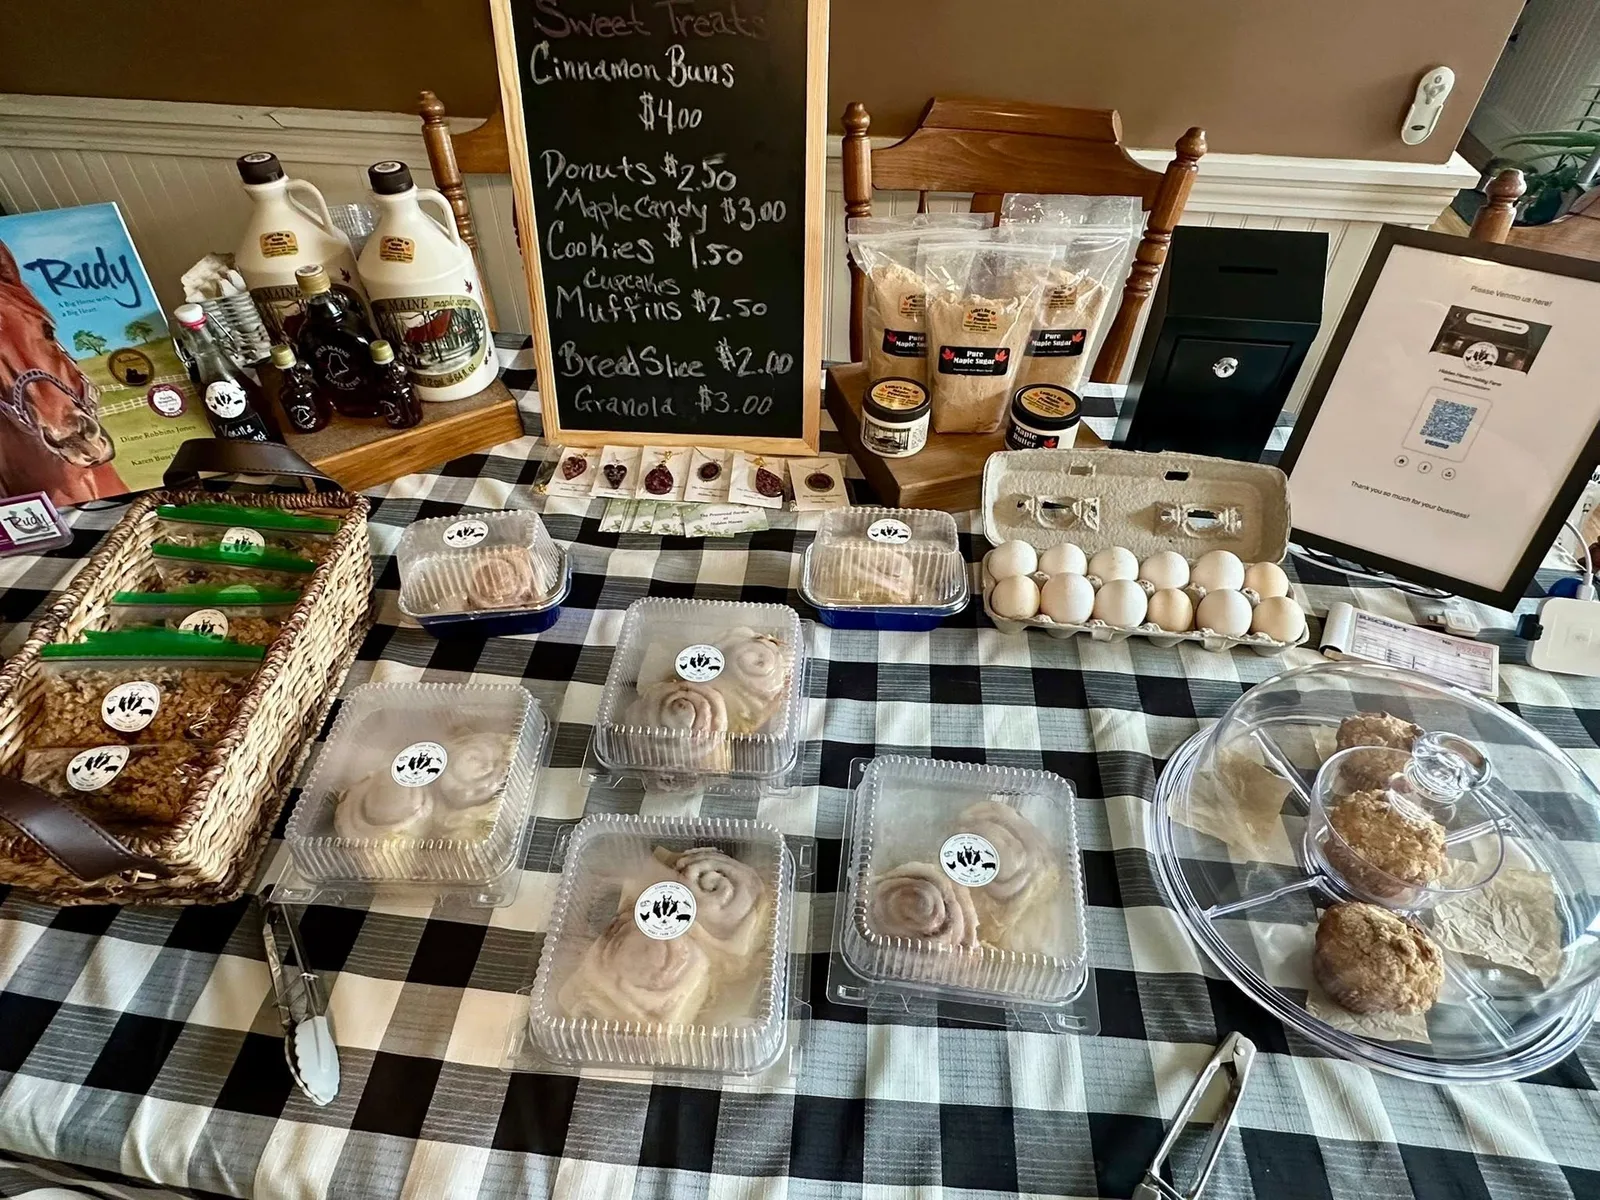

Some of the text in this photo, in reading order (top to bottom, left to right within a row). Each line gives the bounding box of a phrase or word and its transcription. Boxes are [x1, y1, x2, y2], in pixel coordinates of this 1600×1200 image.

[533, 0, 770, 40] Sweet Treats
[530, 41, 735, 88] Cinnamon Buns
[638, 91, 703, 135] $4.00
[540, 149, 737, 192] Donuts $2.50
[554, 187, 787, 235] Maple Candy $3.00
[547, 220, 655, 264] Cookies
[23, 246, 141, 308] Rudy
[583, 267, 681, 296] Cupcakes
[388, 298, 429, 311] MAINE
[556, 285, 768, 323] Muffins $2.50
[1496, 290, 1521, 300] Venmo
[1532, 298, 1553, 307] here!
[558, 337, 794, 379] Bread Slice $2.00
[953, 357, 996, 365] Maple Sugar
[966, 350, 984, 358] Pure
[574, 384, 773, 418] Granola $3.00
[120, 425, 197, 443] Diane Robbins Jones
[218, 424, 255, 438] Vanilla
[1013, 433, 1037, 448] Butter
[1015, 425, 1038, 440] Maple
[131, 457, 154, 466] Karen
[1351, 480, 1370, 491] Thank
[1370, 487, 1383, 495] you
[1391, 493, 1411, 503] much
[1411, 498, 1421, 506] for
[1421, 502, 1437, 510] your
[1436, 505, 1470, 519] business!
[3, 511, 51, 532] Rudy
[1358, 613, 1410, 633] RECEIPT
